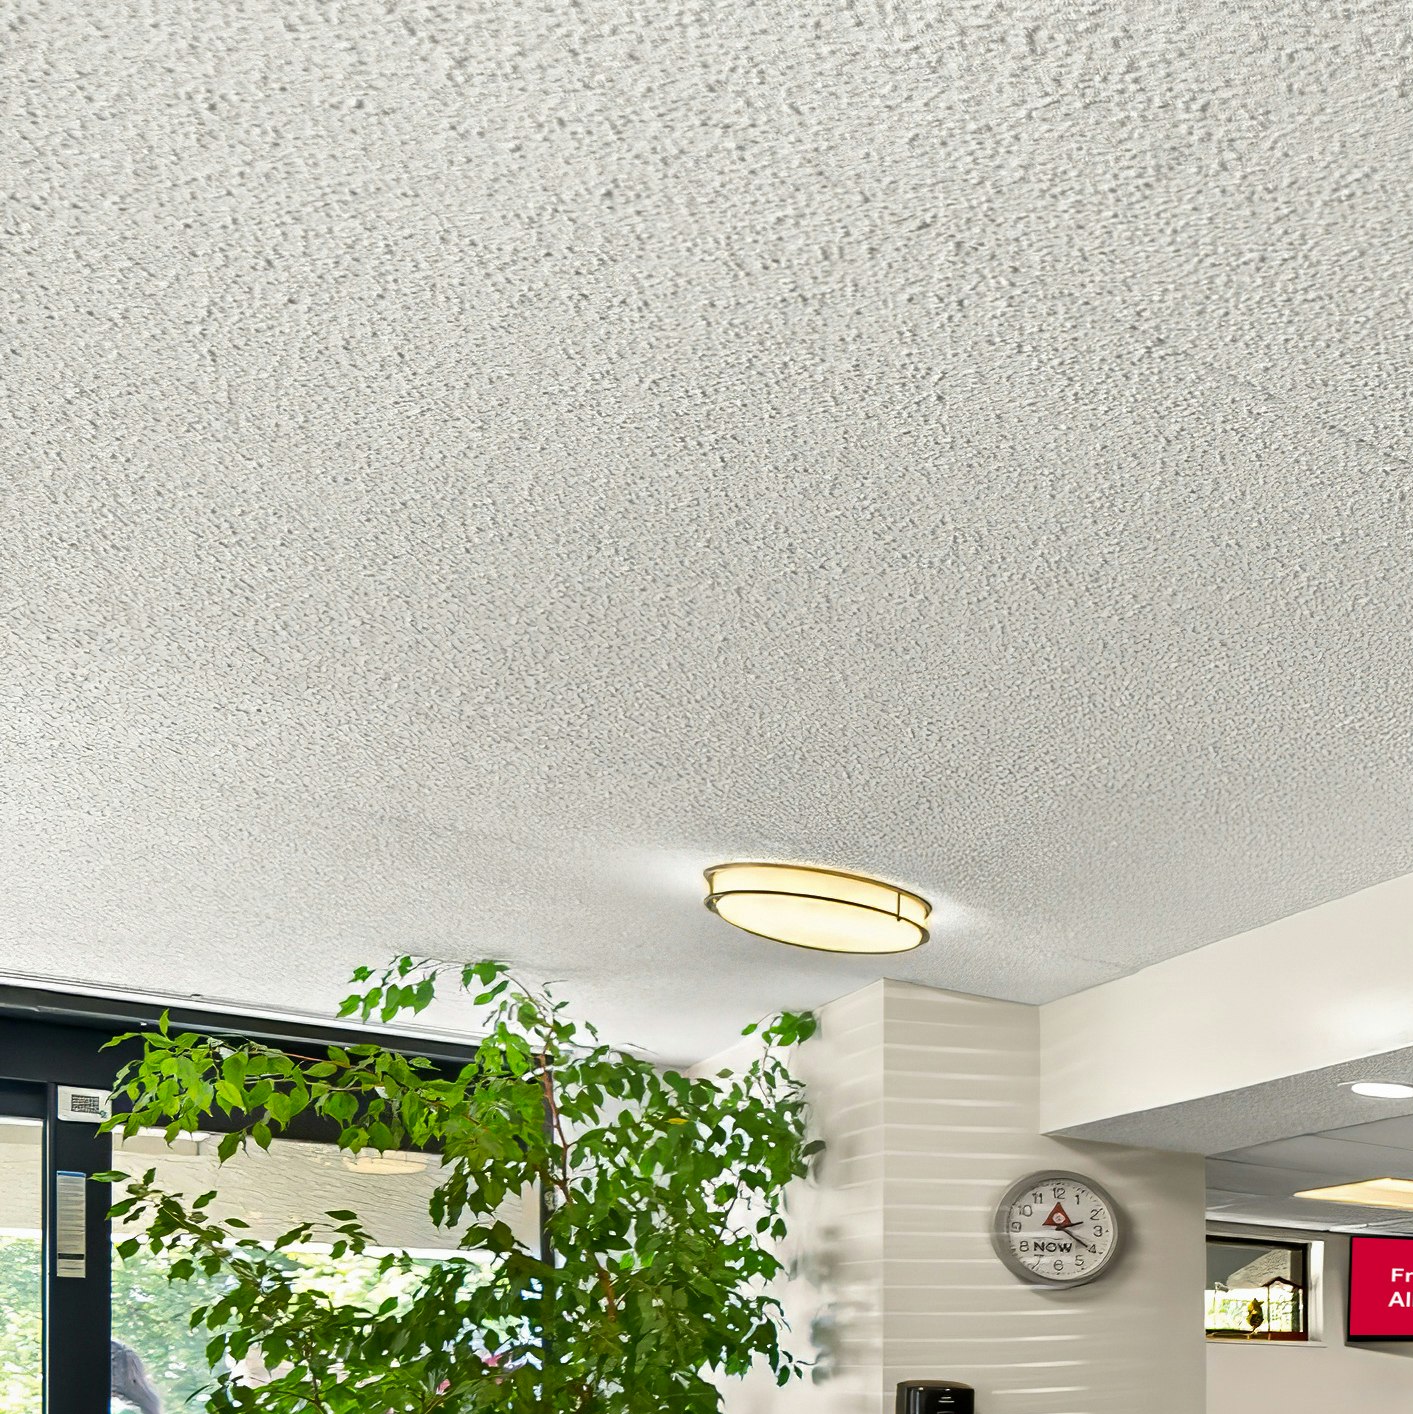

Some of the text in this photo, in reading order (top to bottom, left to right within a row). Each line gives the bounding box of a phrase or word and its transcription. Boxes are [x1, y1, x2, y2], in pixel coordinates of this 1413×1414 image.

[1032, 1191, 1043, 1204] 11
[1052, 1187, 1066, 1200] 12
[1074, 1194, 1080, 1205] 1
[1090, 1209, 1101, 1221] 2
[1011, 1221, 1022, 1233] 9
[1093, 1225, 1103, 1237] 3
[1020, 1240, 1029, 1252] 8
[1033, 1241, 1073, 1253] NOW
[1088, 1244, 1097, 1254] 4
[1053, 1260, 1064, 1271] 6
[1075, 1255, 1085, 1266] 5
